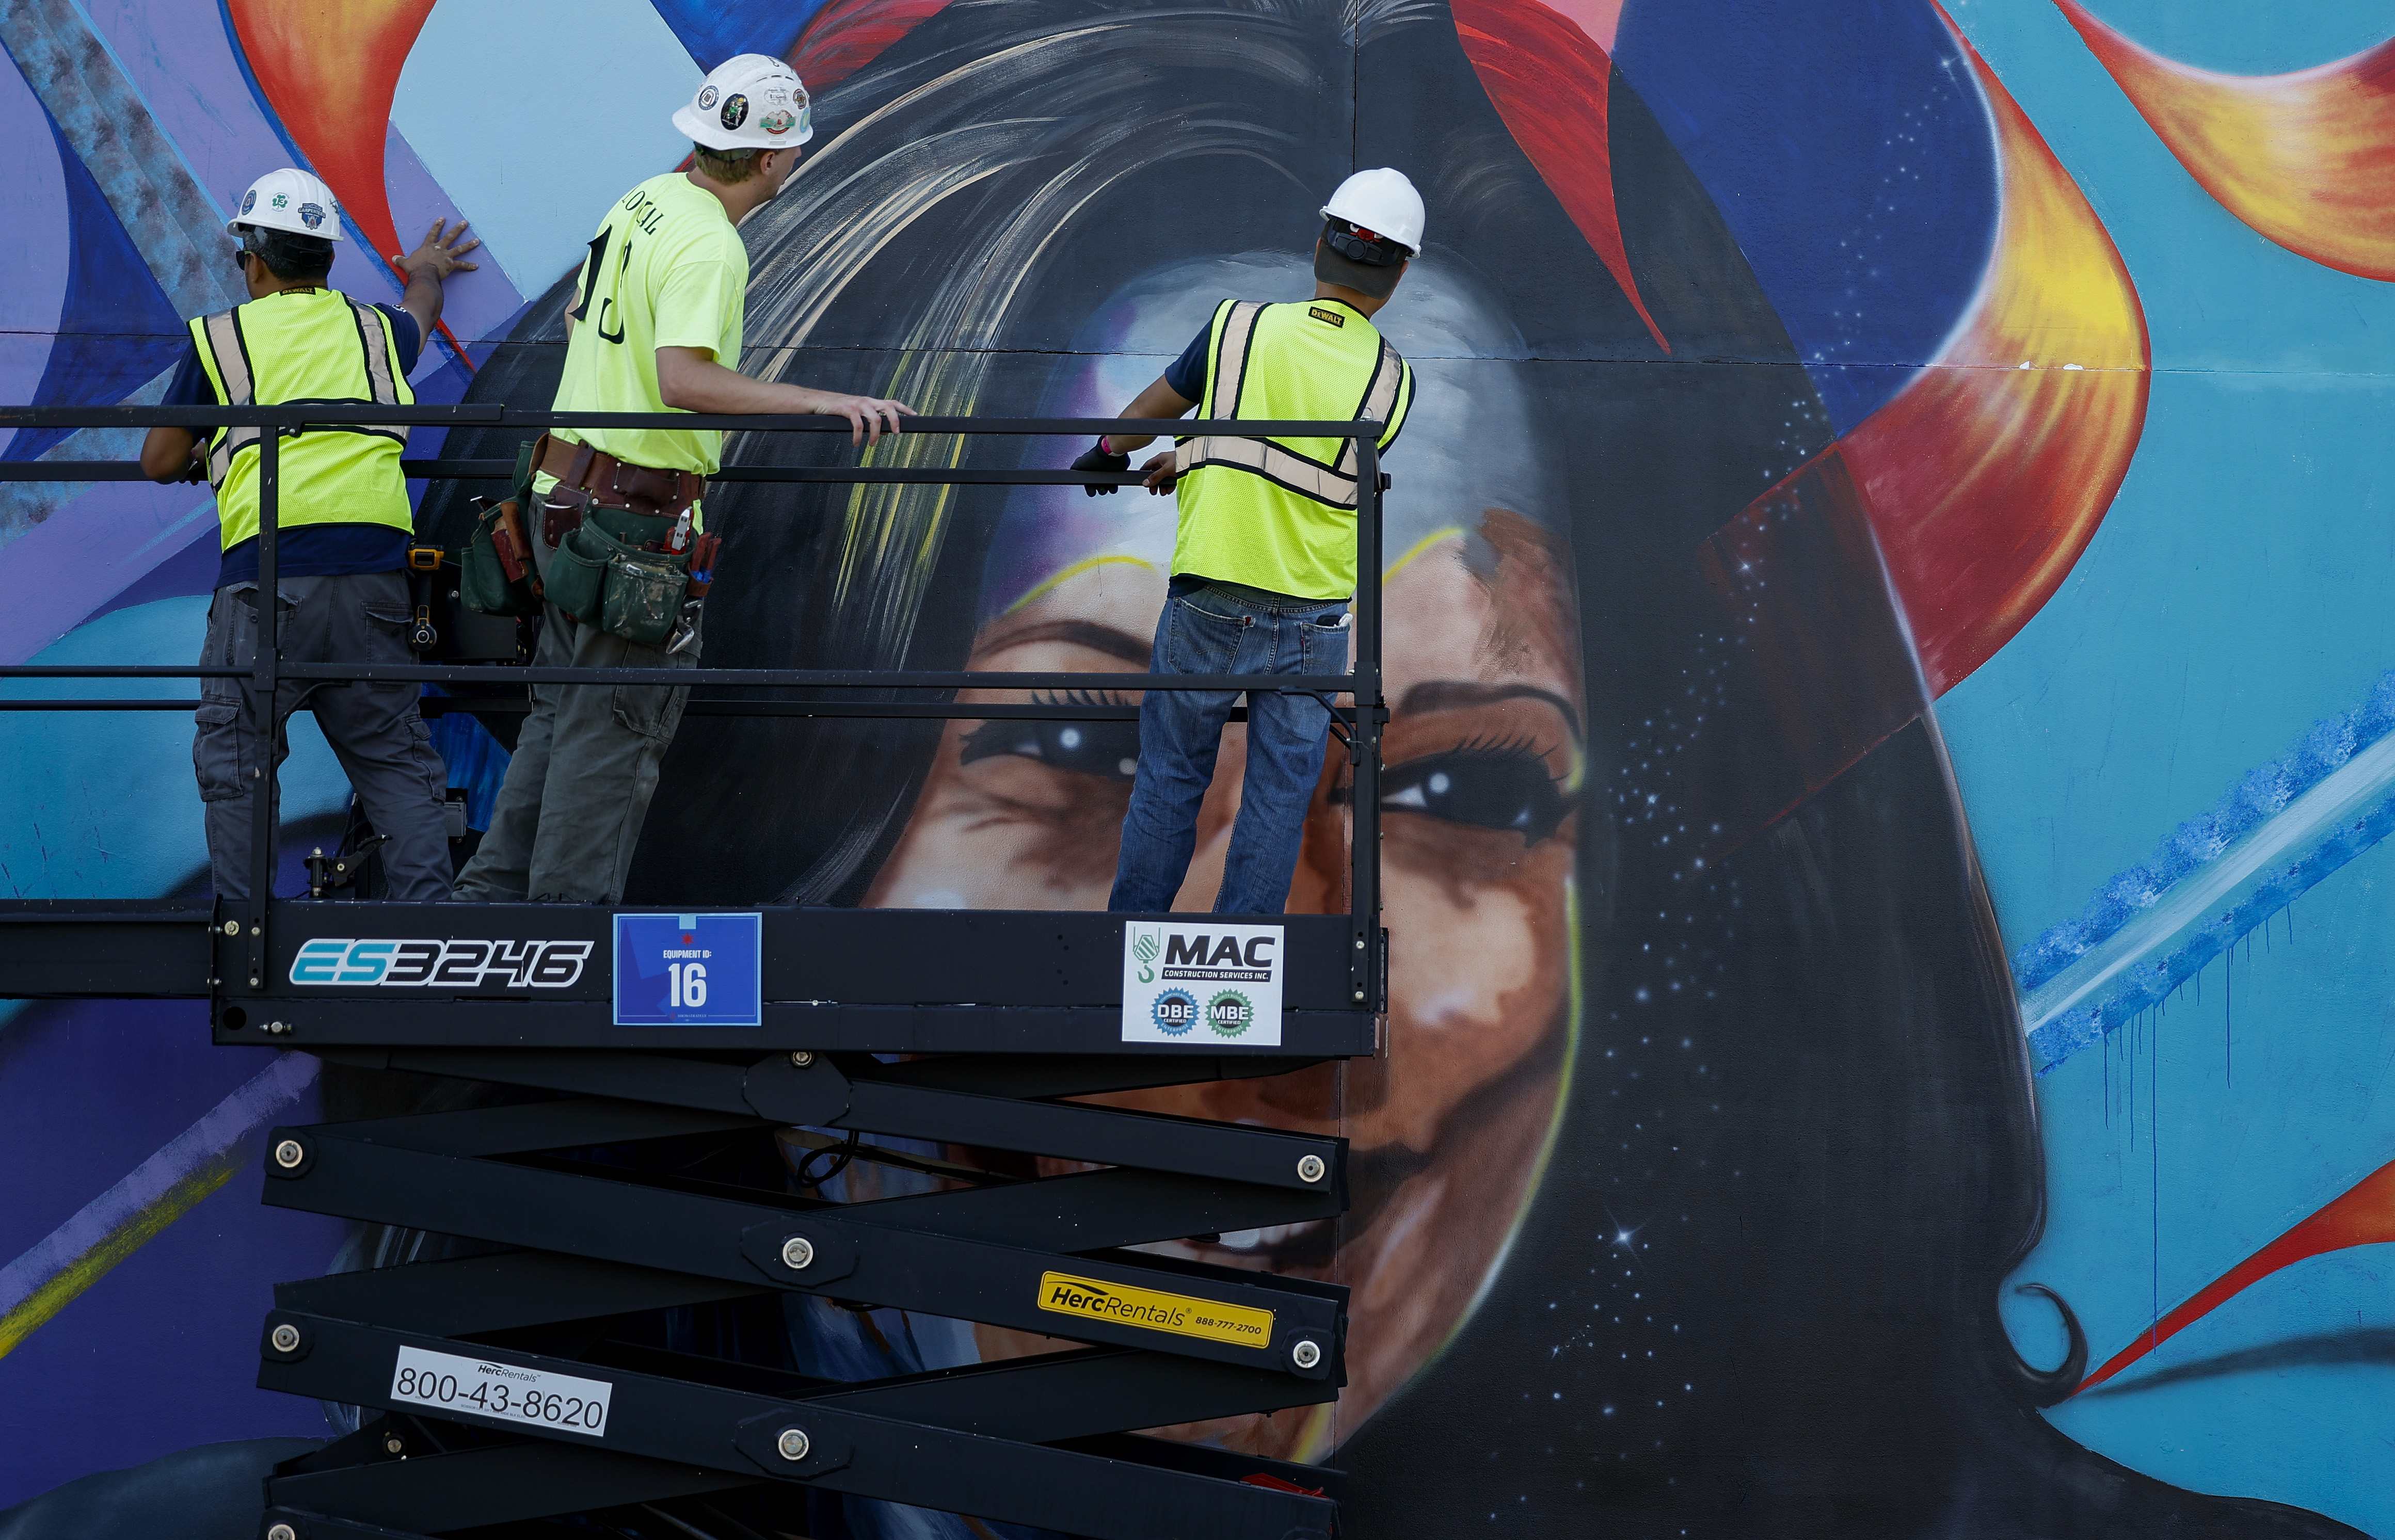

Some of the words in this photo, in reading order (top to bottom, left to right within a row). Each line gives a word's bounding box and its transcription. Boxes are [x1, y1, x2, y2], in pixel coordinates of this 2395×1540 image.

[621, 185, 665, 235] LOCAL
[663, 950, 701, 959] EQUIPMENT
[702, 950, 712, 958] ID:
[1165, 934, 1275, 967] MAC
[289, 938, 595, 987] ES3246
[1164, 970, 1218, 978] CONSTRUCTION
[668, 962, 707, 1007] 16
[1213, 994, 1231, 1005] MINORITY
[1231, 993, 1246, 1005] BUSINESS
[1157, 1004, 1194, 1018] DBE
[1210, 1006, 1249, 1020] MBE
[1161, 1023, 1189, 1032] ENTERPRISE
[1215, 1024, 1243, 1033] ENTERPRISE
[1195, 1316, 1262, 1335] 888-777-2700
[397, 1367, 603, 1429] 800-43-8620
